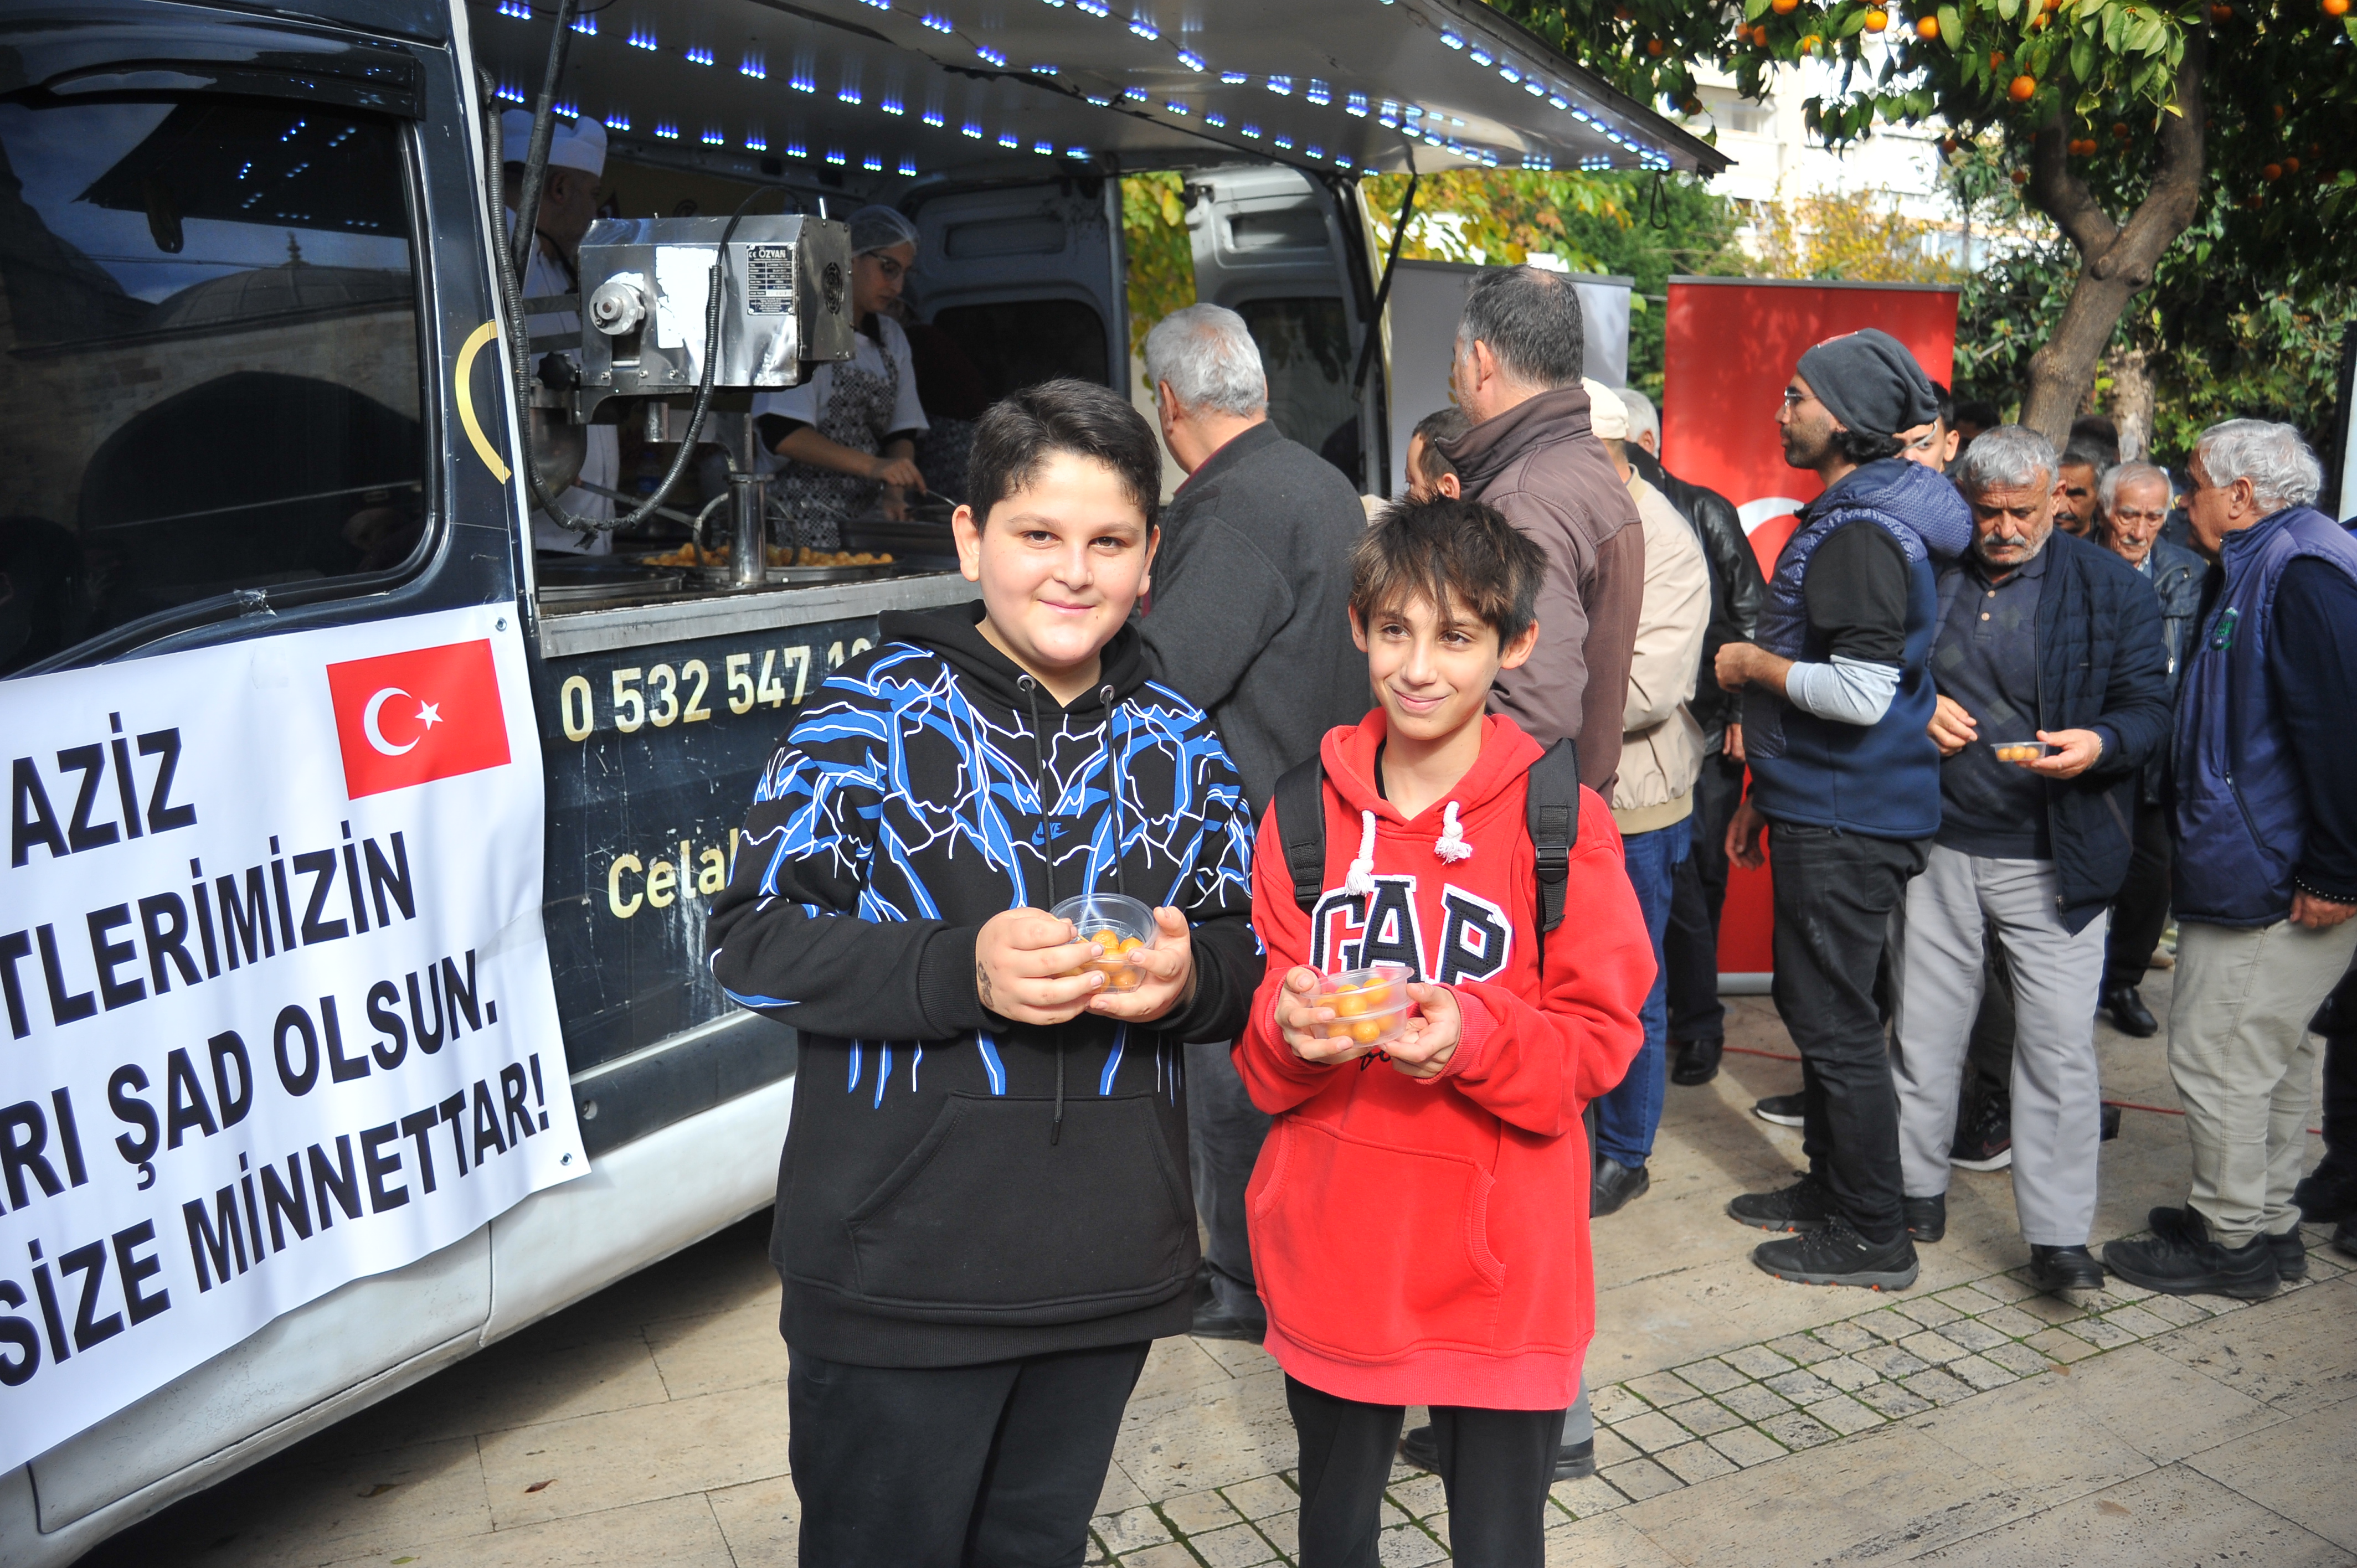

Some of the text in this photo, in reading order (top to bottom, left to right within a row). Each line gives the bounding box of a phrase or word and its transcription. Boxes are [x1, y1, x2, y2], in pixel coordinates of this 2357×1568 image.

[561, 675, 594, 742] 0
[613, 659, 711, 733] 532
[726, 645, 811, 714] 547
[12, 711, 197, 869] AZİZ
[0, 820, 416, 1040] TLERİMİZİN
[1309, 874, 1512, 986] GAP
[0, 948, 498, 1217] RI ŞAD OLSUN.
[0, 1053, 549, 1387] SİZE MİNNETTAR!
